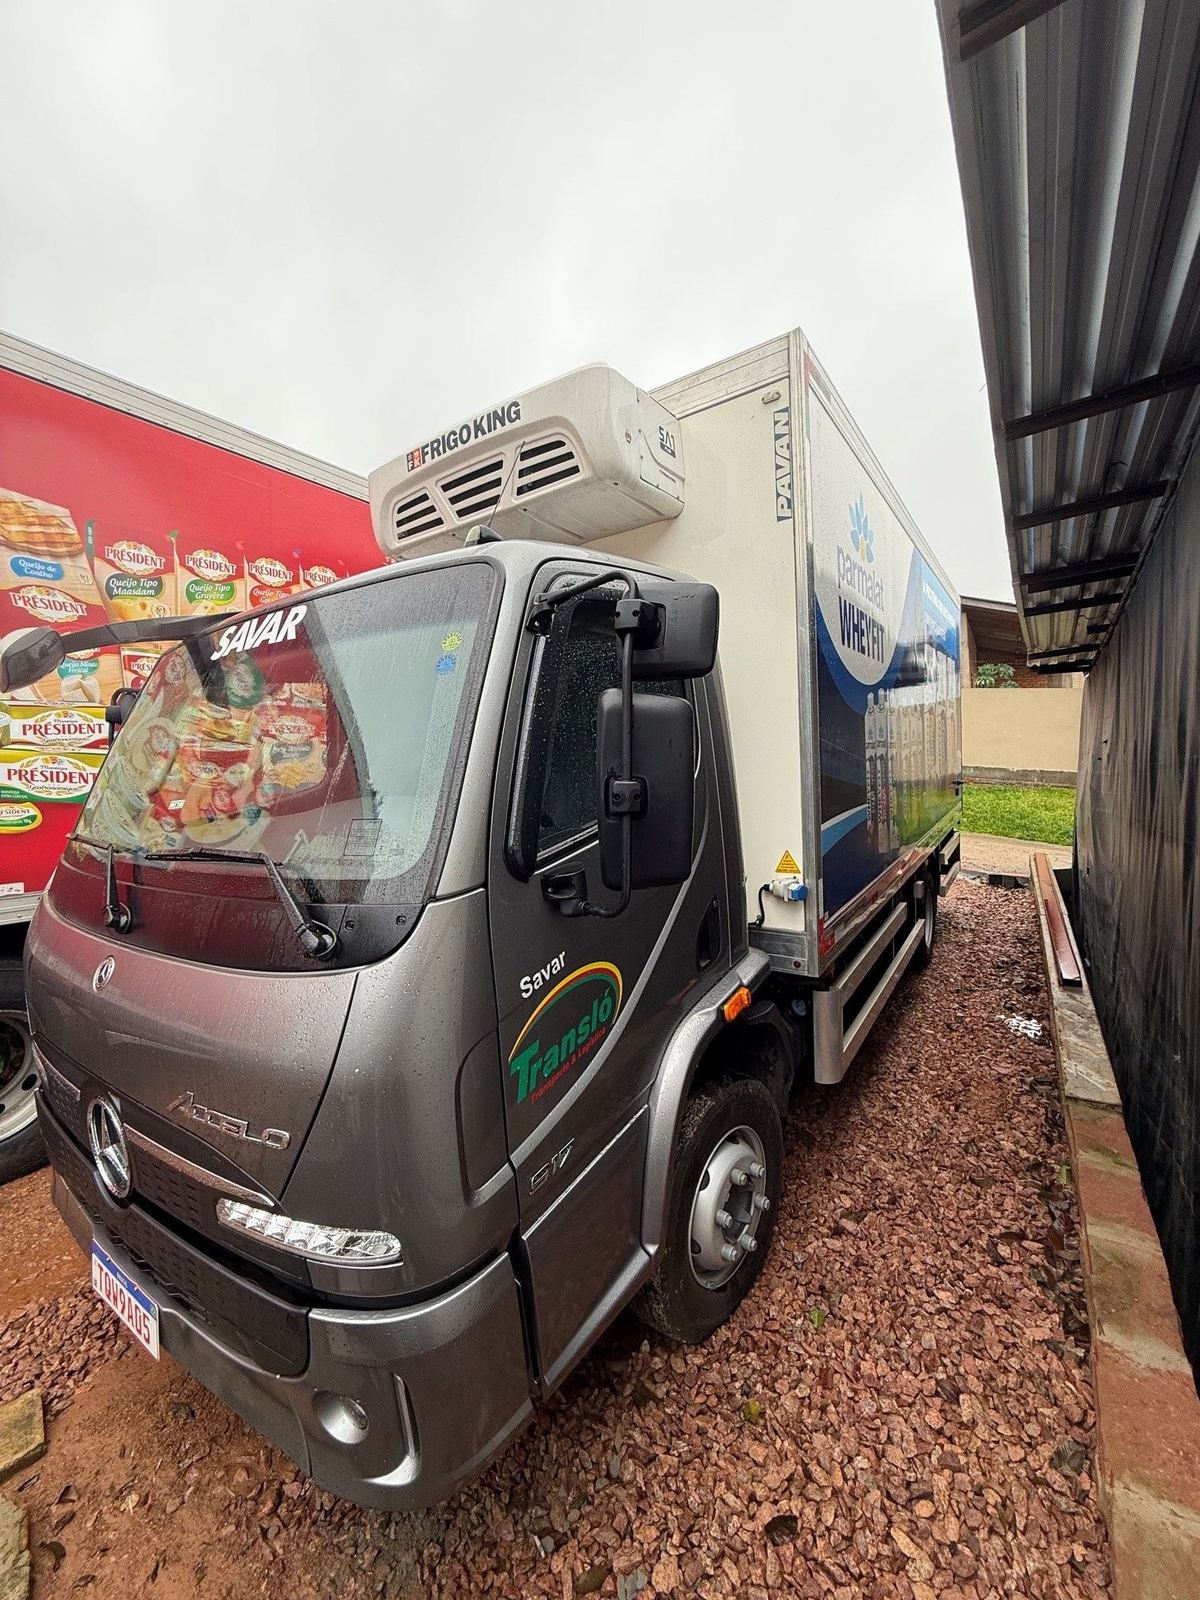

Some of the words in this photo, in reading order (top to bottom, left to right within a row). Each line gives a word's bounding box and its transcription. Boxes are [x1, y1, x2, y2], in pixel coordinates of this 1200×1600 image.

[774, 408, 792, 519] PAVAN
[18, 559, 45, 571] Queijo
[106, 547, 164, 569] PRÉSIDENT
[186, 555, 236, 575] PRÉSIDENT
[25, 567, 54, 579] Coalho
[251, 564, 292, 581] PRÉSIDENT
[837, 544, 884, 612] parmalat
[109, 578, 137, 589] Queijo
[140, 578, 159, 588] Tipo
[112, 587, 155, 597] Maasdam
[189, 583, 212, 593] Queijo
[215, 583, 231, 592] Tipo
[11, 592, 86, 615] PRÉSIDENT
[210, 605, 308, 661] SAVAR
[22, 721, 105, 738] PRÉSIDENT
[519, 950, 566, 999] Savar
[510, 986, 612, 1104] Transló
[97, 1264, 151, 1345] TQW9A05
